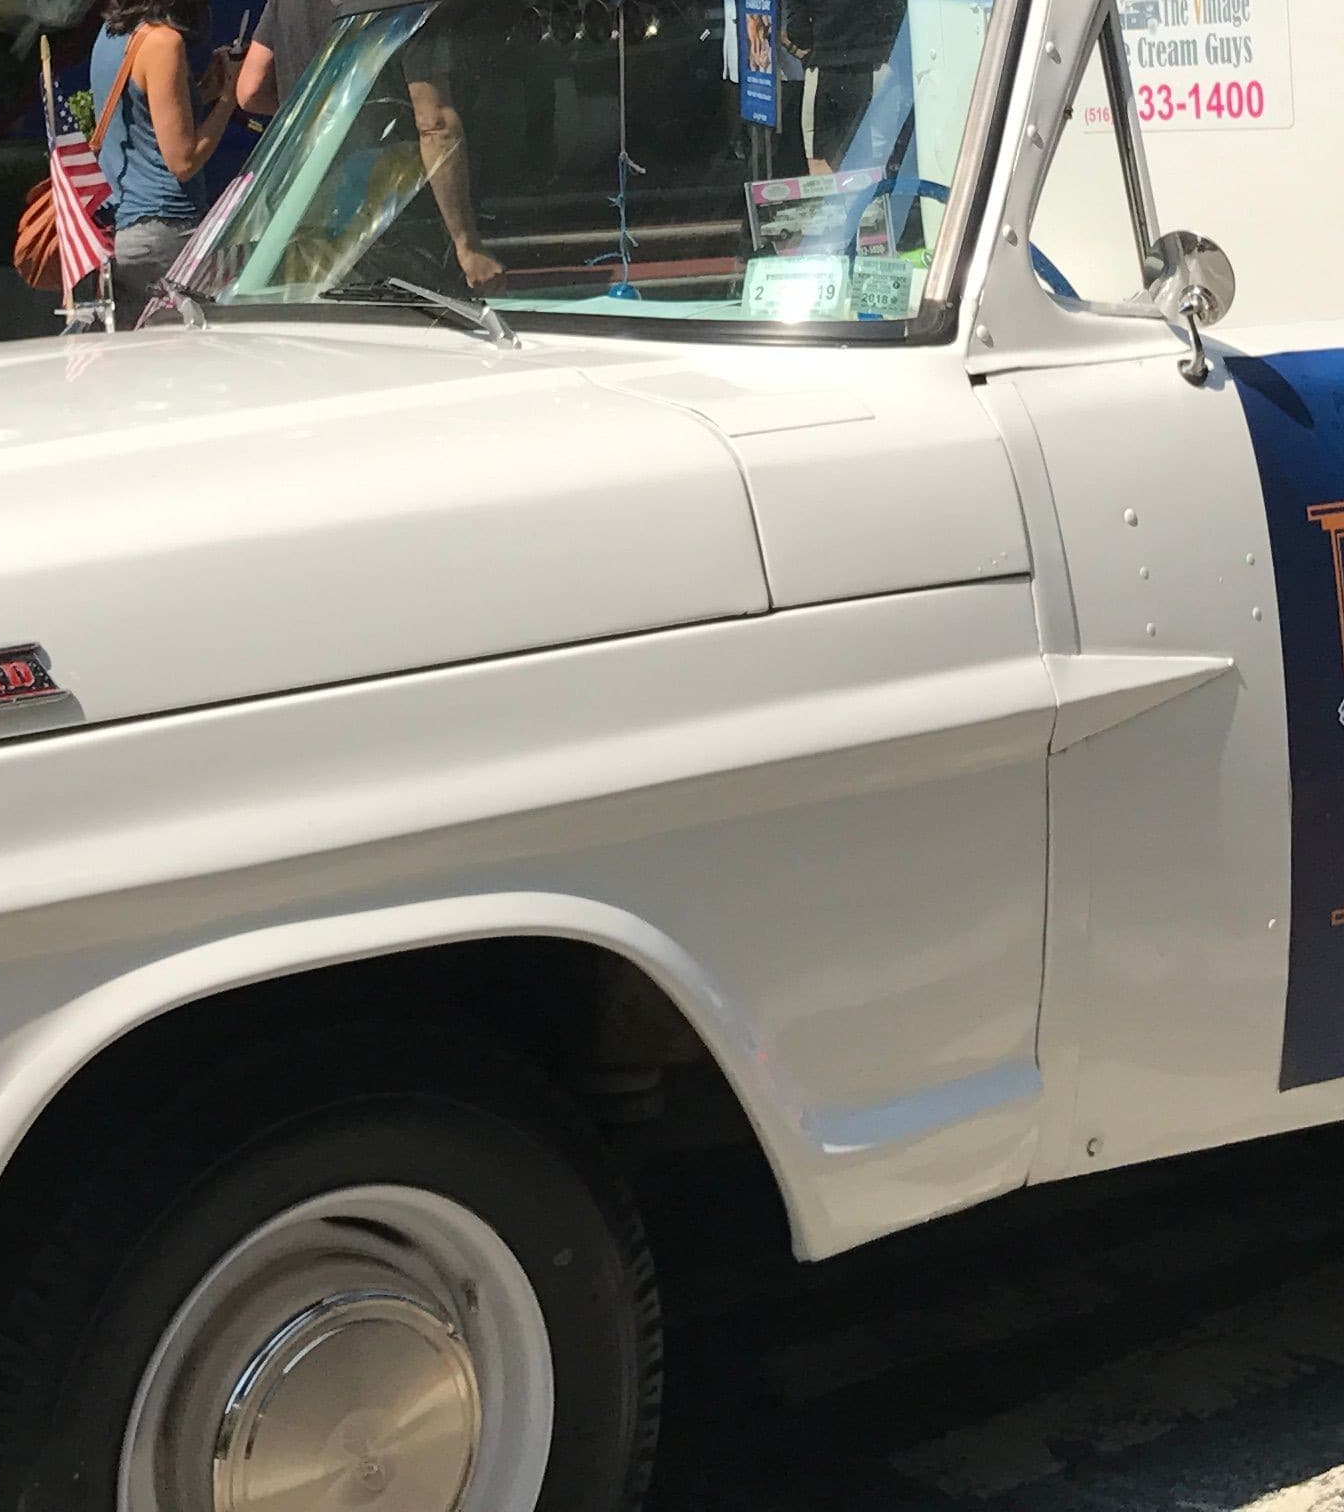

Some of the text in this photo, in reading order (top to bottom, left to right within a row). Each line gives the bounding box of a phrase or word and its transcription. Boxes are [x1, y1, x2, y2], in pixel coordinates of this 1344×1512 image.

[1137, 37, 1198, 68] Cream
[1205, 33, 1253, 68] Guys
[1138, 80, 1264, 121] 33-1400
[862, 292, 888, 305] 2018
